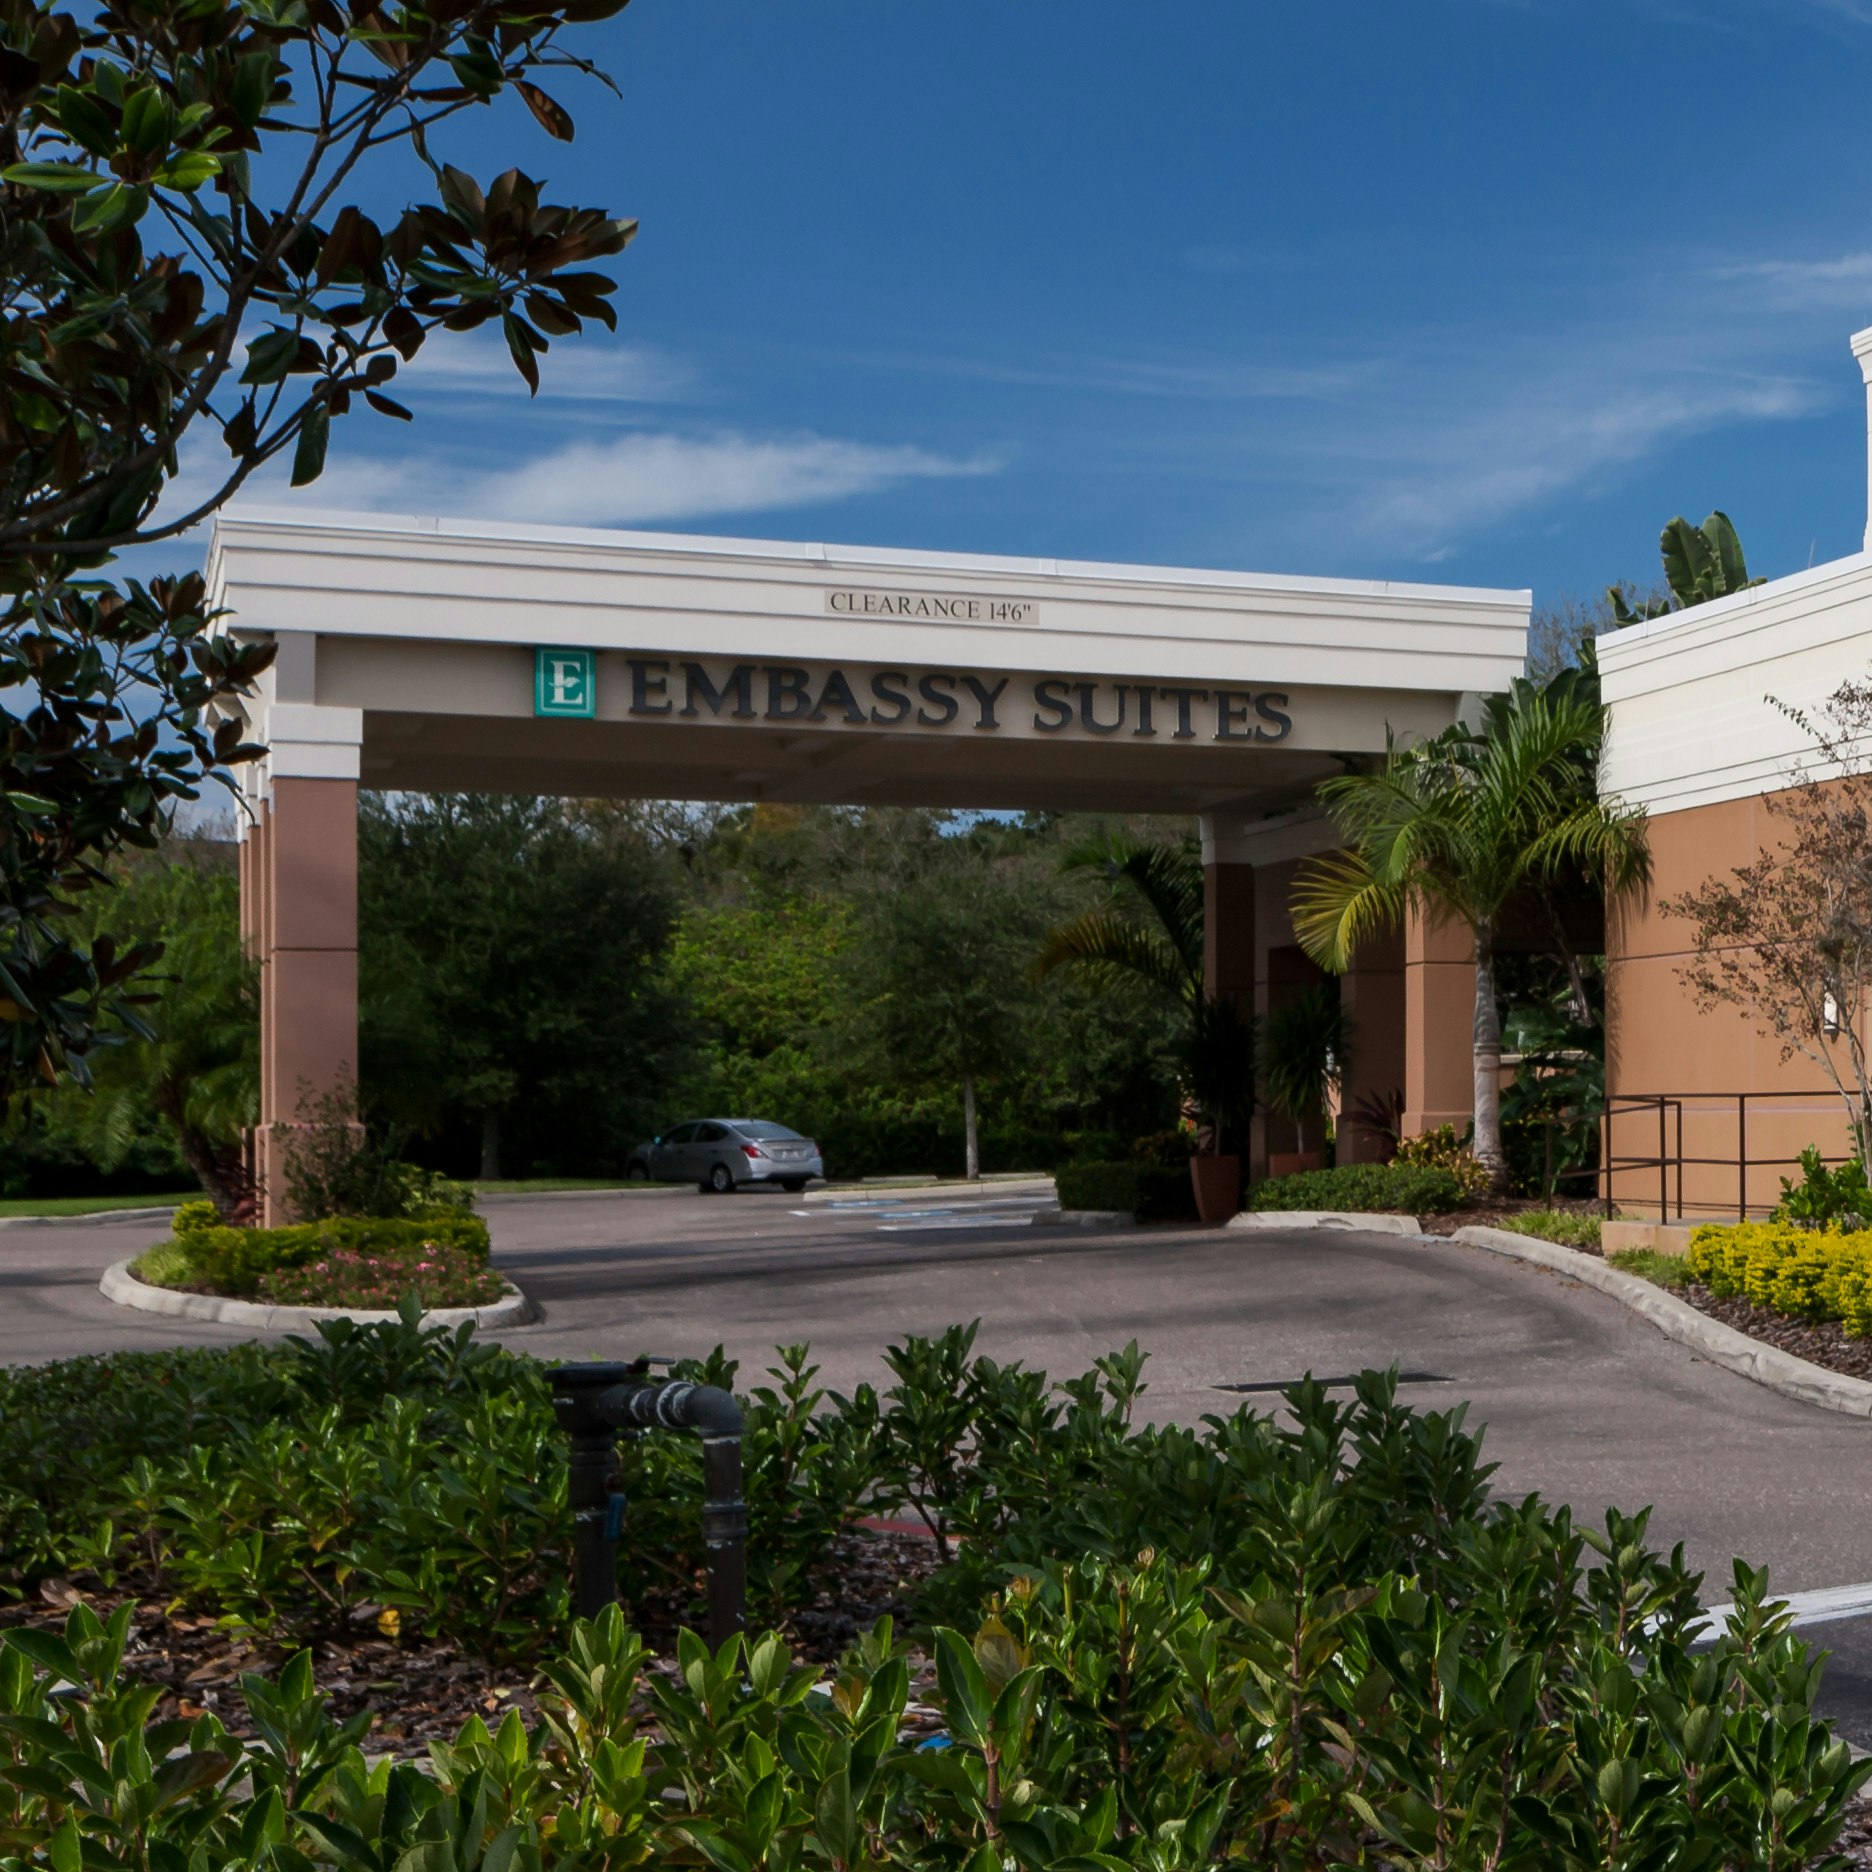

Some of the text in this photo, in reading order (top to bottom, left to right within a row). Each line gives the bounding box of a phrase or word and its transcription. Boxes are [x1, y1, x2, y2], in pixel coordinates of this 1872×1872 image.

[830, 592, 1031, 621] CLEARANCE 14'6"
[549, 659, 583, 705] E
[626, 659, 1293, 742] EMBASSY SUITES
